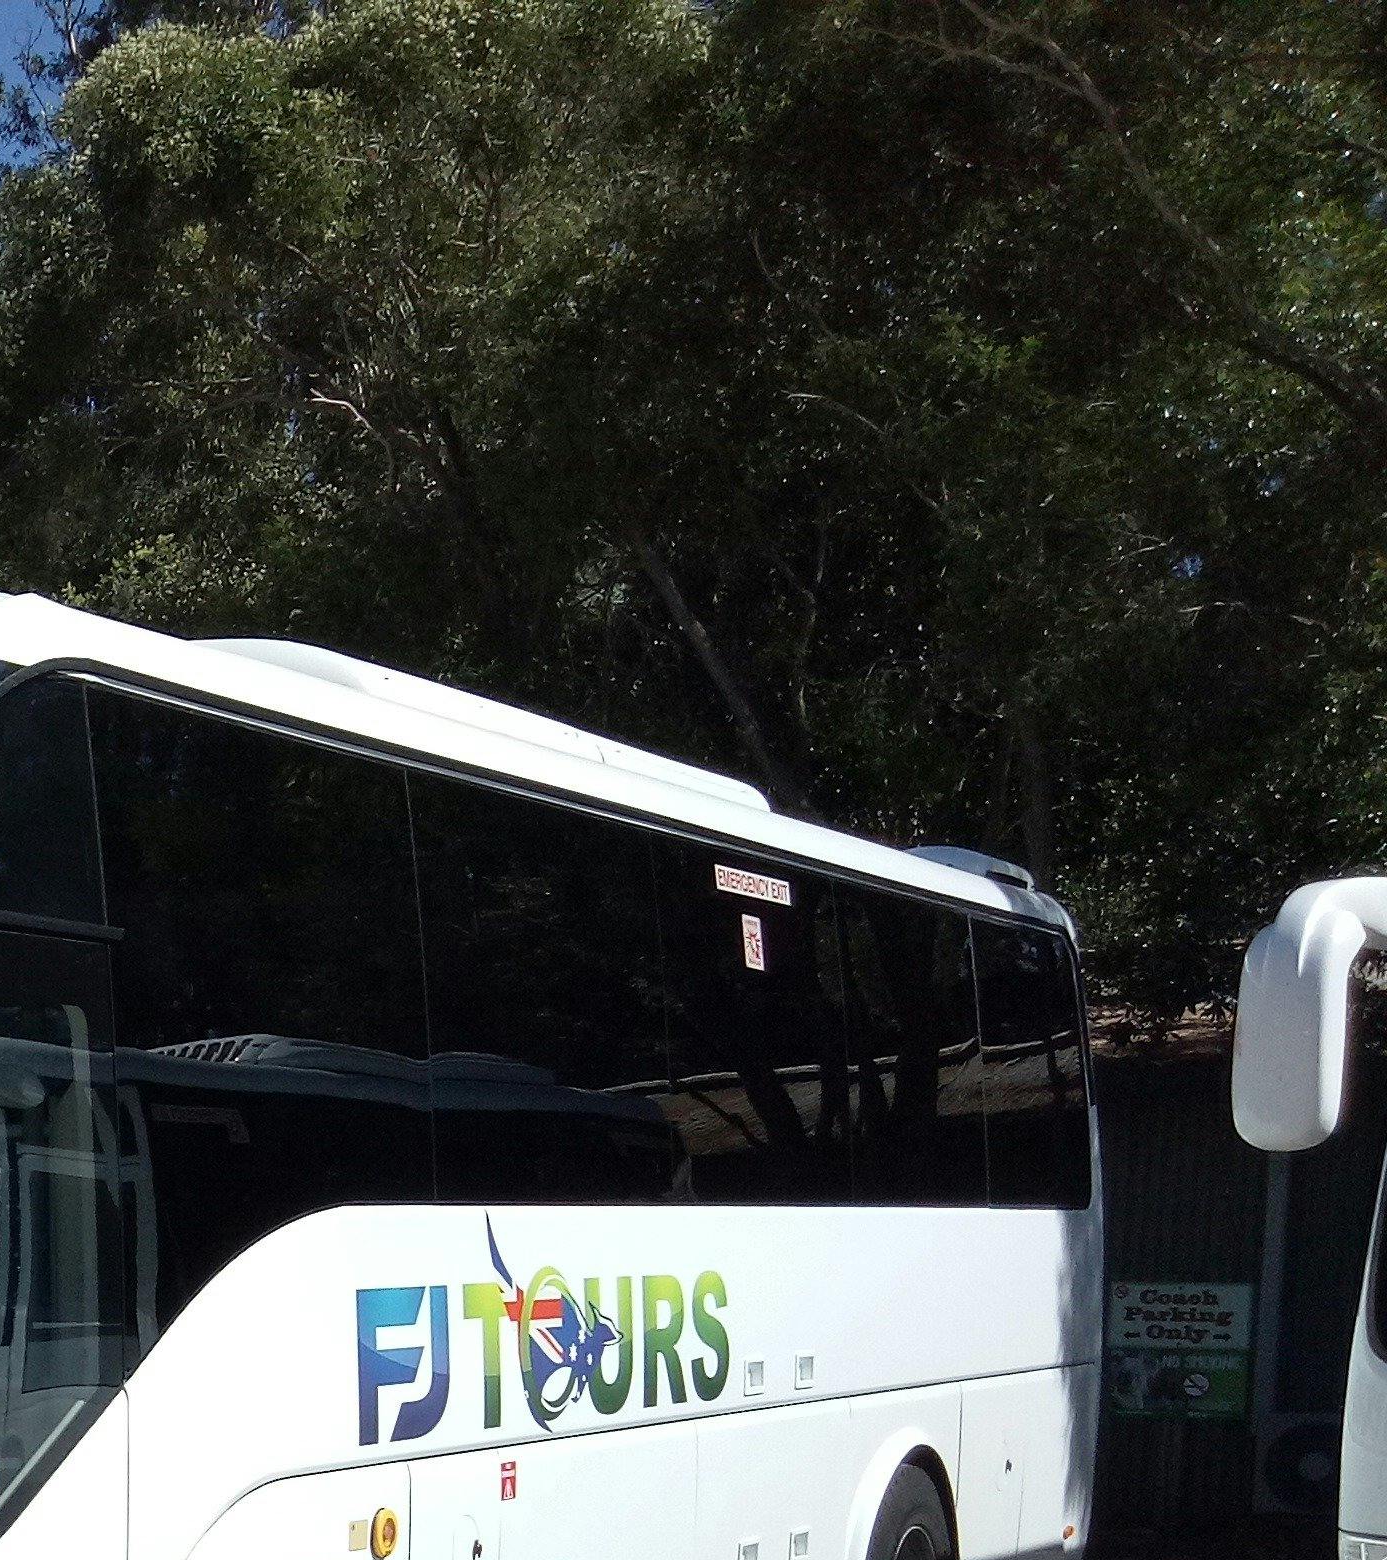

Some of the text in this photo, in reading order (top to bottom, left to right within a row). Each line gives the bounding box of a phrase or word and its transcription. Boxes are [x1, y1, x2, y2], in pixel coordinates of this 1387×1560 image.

[717, 868, 788, 901] EMERGENCY EXIT
[1138, 1289, 1219, 1306] Coach
[1123, 1306, 1234, 1327] Parking
[1145, 1324, 1211, 1344] Only
[355, 1265, 730, 1446] FJ TOURS
